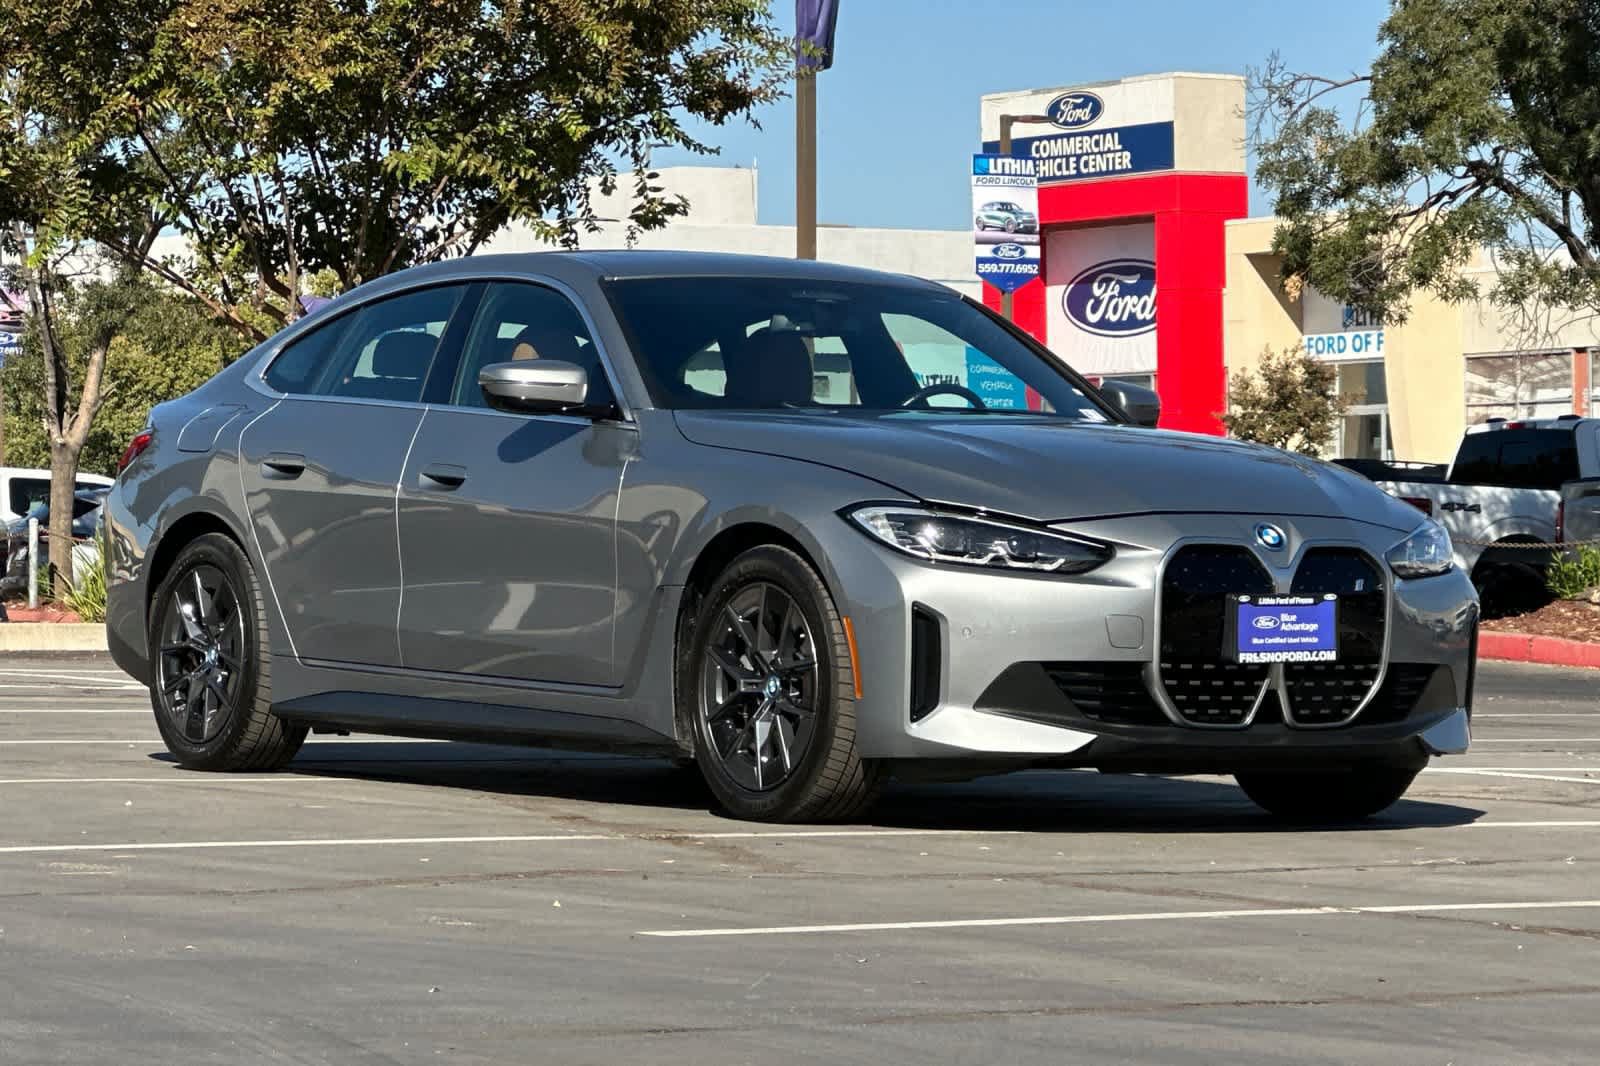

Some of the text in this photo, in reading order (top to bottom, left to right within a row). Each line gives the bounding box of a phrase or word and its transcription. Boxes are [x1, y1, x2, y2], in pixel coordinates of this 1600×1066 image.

[1056, 97, 1093, 123] Ford
[1031, 132, 1122, 158] COMMERCIAL
[988, 158, 1036, 175] LITHIA
[1036, 151, 1133, 178] HICLE CENTER
[1002, 177, 1035, 186] LINCOLN
[1085, 272, 1157, 323] Ford
[1305, 336, 1347, 355] FORD
[1352, 333, 1373, 353] OF
[1280, 613, 1297, 622] Blue
[1280, 623, 1319, 632] Advantage
[1239, 651, 1337, 664] FRESNOFORD.COM
